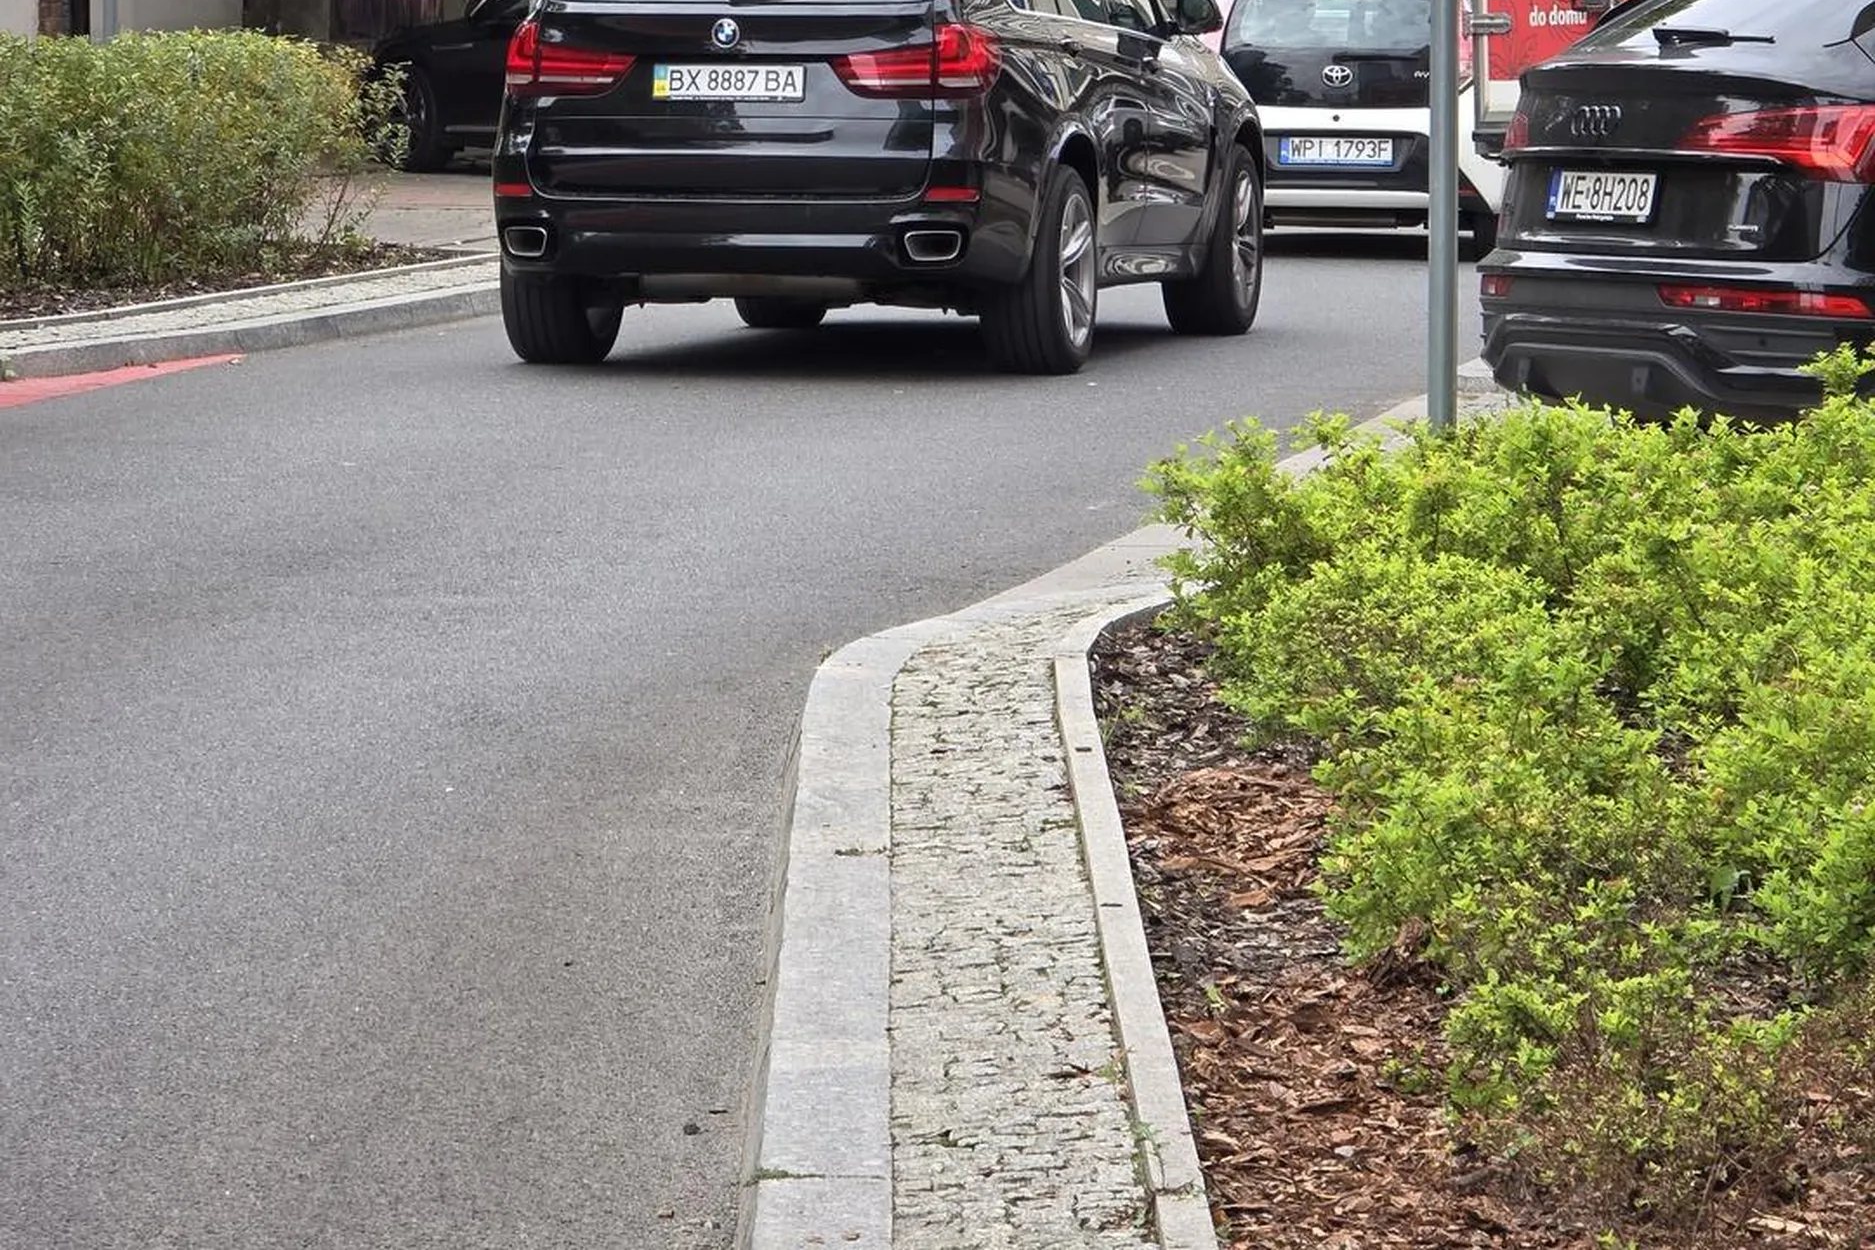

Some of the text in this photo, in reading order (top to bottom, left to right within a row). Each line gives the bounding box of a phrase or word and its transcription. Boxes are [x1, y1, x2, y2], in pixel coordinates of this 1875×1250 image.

[1529, 3, 1588, 26] do domu
[669, 69, 701, 91] BX
[707, 70, 759, 91] 8887
[765, 70, 797, 92] BA
[1290, 140, 1390, 159] WPI 1793F
[1589, 177, 1651, 212] 8H208
